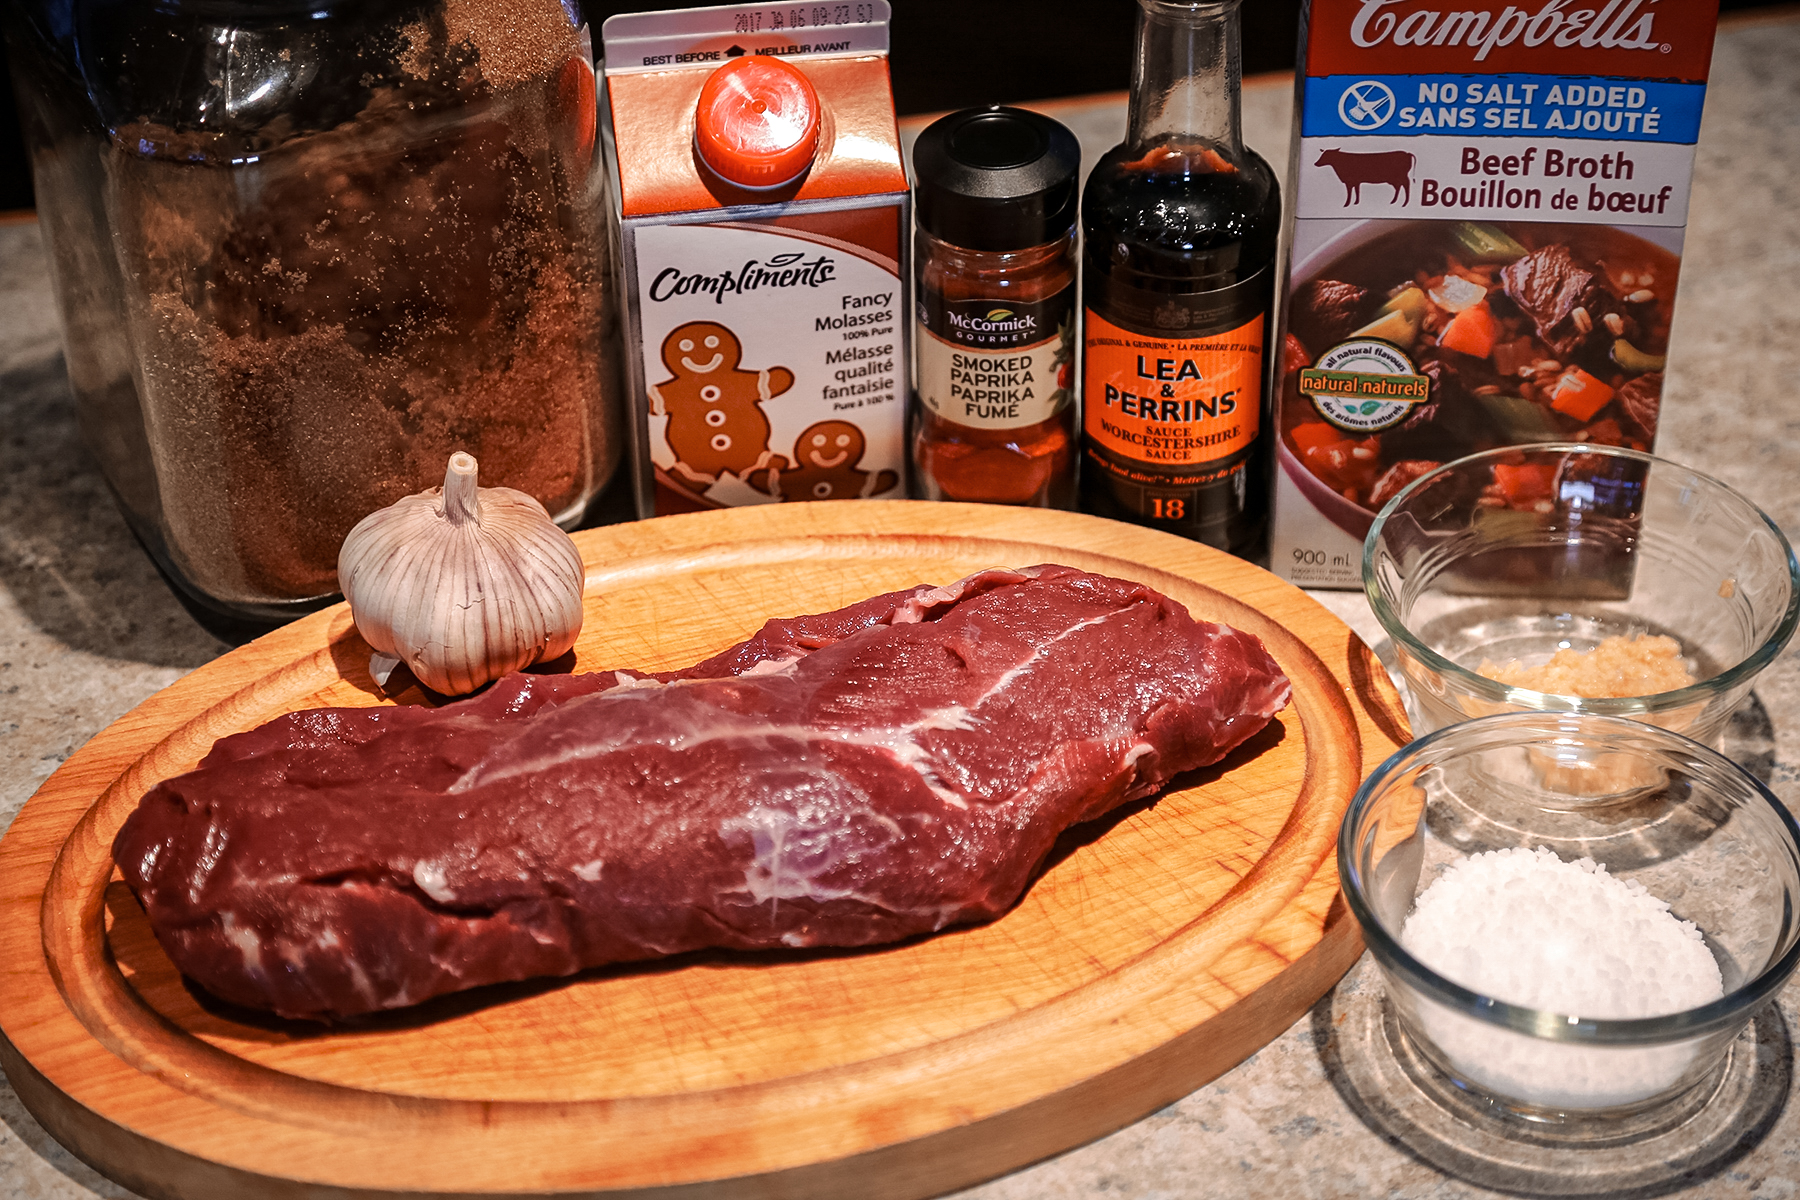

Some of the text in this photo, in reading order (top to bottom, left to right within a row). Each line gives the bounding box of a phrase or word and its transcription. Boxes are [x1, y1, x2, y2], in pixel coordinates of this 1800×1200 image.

[734, 12, 762, 32] 2017
[769, 11, 784, 30] JA
[790, 8, 805, 28] 06
[1350, 0, 1660, 61] Campbells
[643, 51, 721, 66] BEST BEFORE
[755, 41, 851, 57] MEILLEUR AVANT
[1418, 83, 1646, 109] NO SALT ADDED
[1398, 106, 1661, 134] SANS SEL AJOUTÉ
[1460, 147, 1635, 181] Beef Broth
[1420, 179, 1673, 215] Bouillon de bœuf
[649, 253, 837, 304] Compliments
[842, 292, 893, 310] Fancy
[815, 310, 893, 332] Molasses
[947, 311, 1037, 332] McCormick
[842, 326, 894, 340] 100% Pure
[825, 344, 894, 365] Mélasse
[1132, 341, 1169, 351] GENUINE
[1177, 343, 1188, 351] LA
[1189, 342, 1230, 352] PREMIÈRE
[1230, 344, 1240, 352] ET
[952, 353, 1033, 373] SMOKED
[1137, 354, 1203, 382] LEA
[1325, 346, 1407, 373] all natural flavours
[834, 358, 894, 383] qualité
[951, 368, 1034, 388] PAPRIKA
[822, 377, 894, 400] fantaisie
[951, 384, 1035, 404] PAPRIKA
[1160, 383, 1175, 399] &
[833, 401, 856, 411] Pure
[866, 395, 884, 405] 100
[885, 393, 895, 401] %
[965, 401, 1020, 419] FUMÉ
[1105, 383, 1238, 423] PERRINS
[1322, 400, 1404, 427] des arômes naturels
[1100, 418, 1241, 450] WORCESTERSHIRE
[1145, 425, 1192, 438] SAUCE
[1145, 449, 1192, 461] SAUCE
[1152, 498, 1185, 520] 18
[1292, 548, 1327, 566] 900
